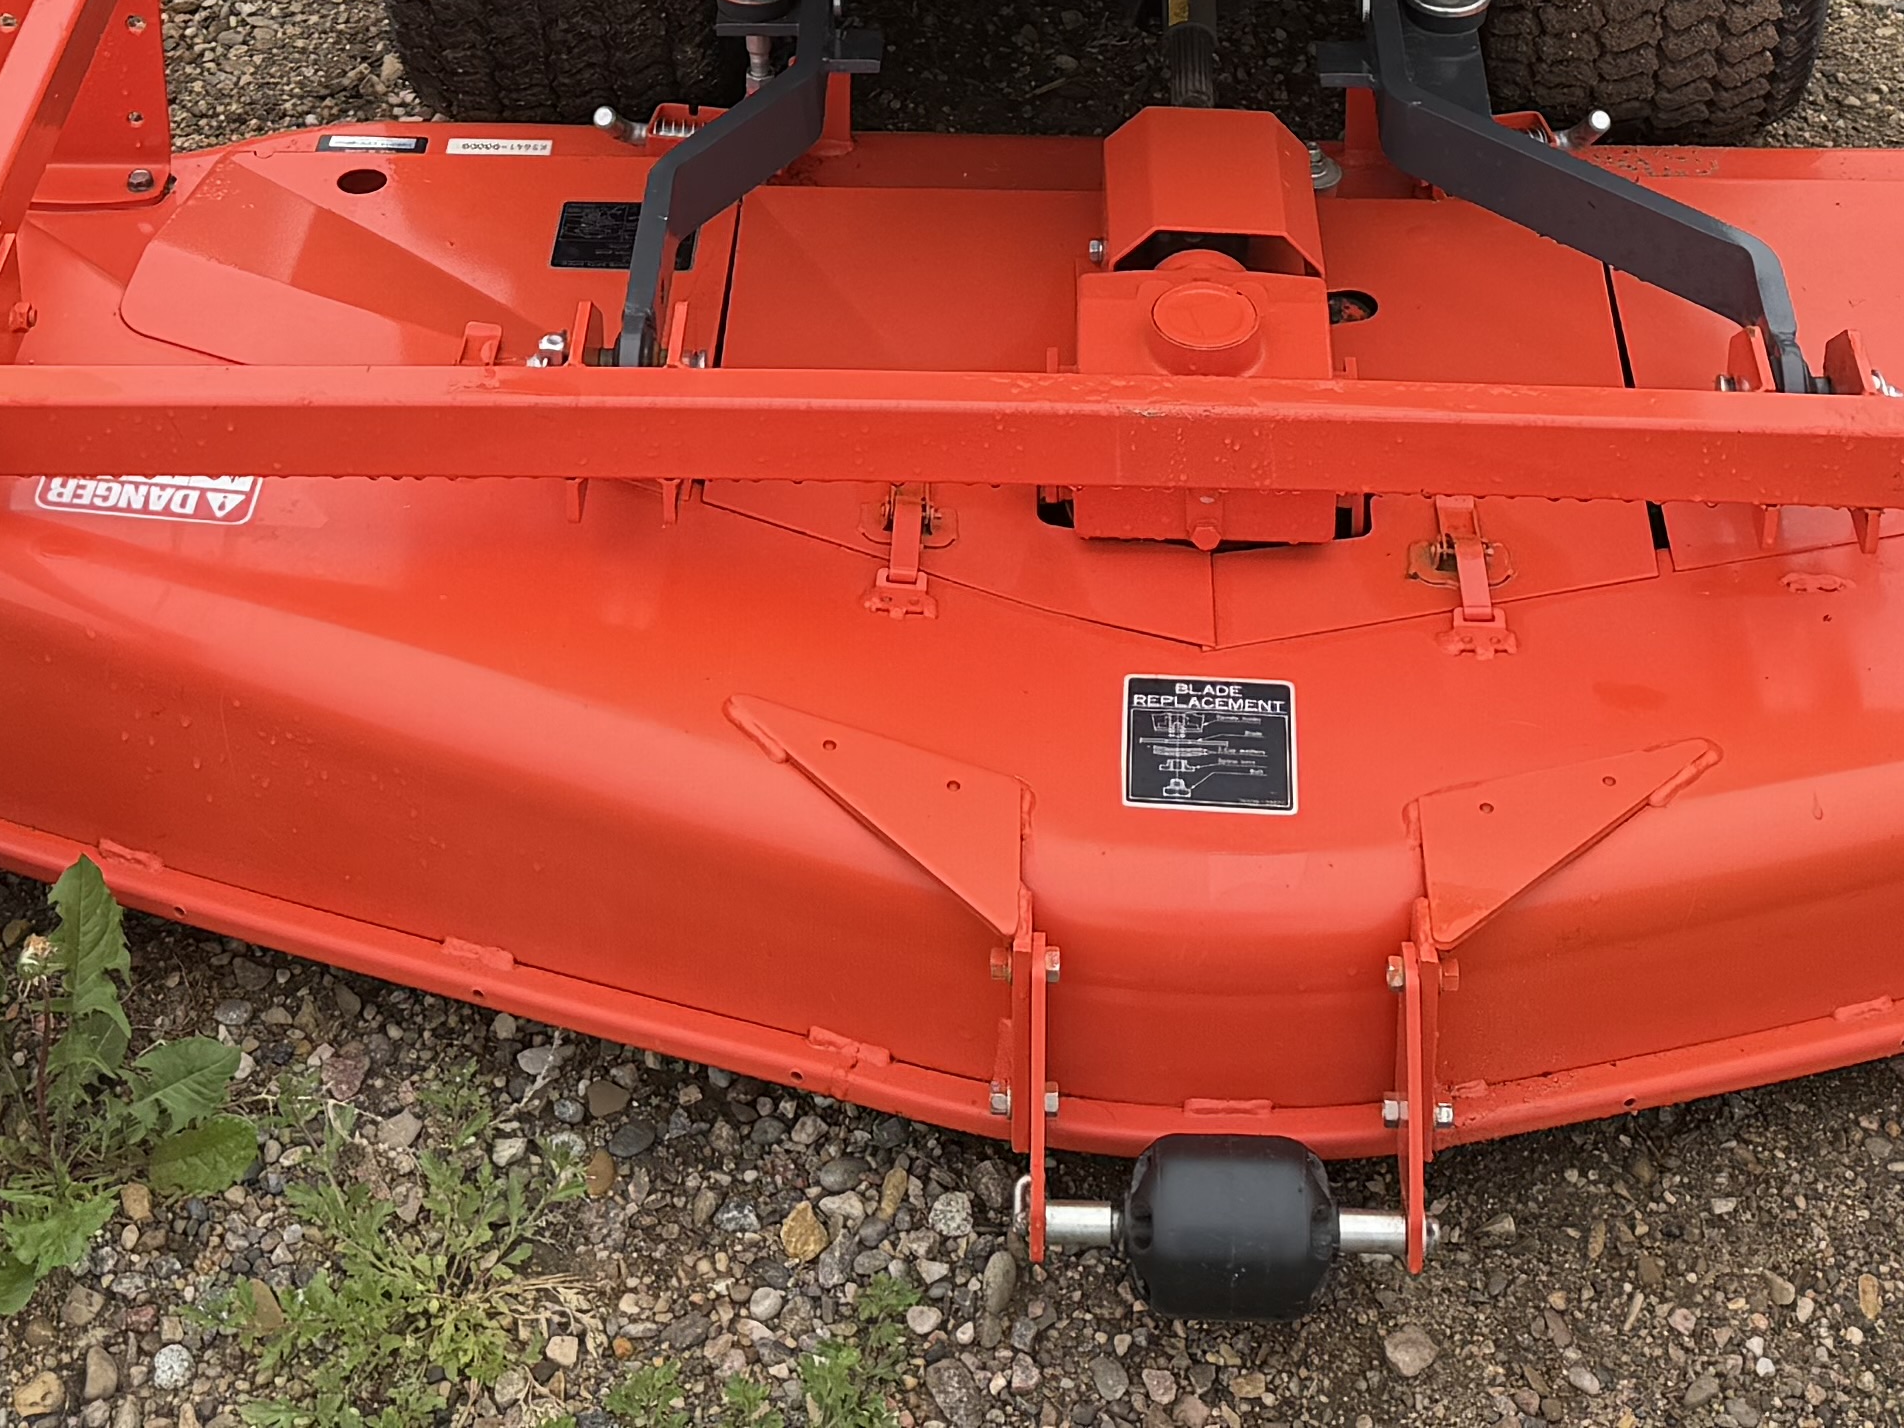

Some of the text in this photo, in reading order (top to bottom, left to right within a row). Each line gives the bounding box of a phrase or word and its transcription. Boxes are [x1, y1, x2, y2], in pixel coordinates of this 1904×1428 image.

[47, 476, 201, 515] DANGER
[1175, 682, 1243, 697] BLADE
[1132, 694, 1286, 713] REPLACEMENT
